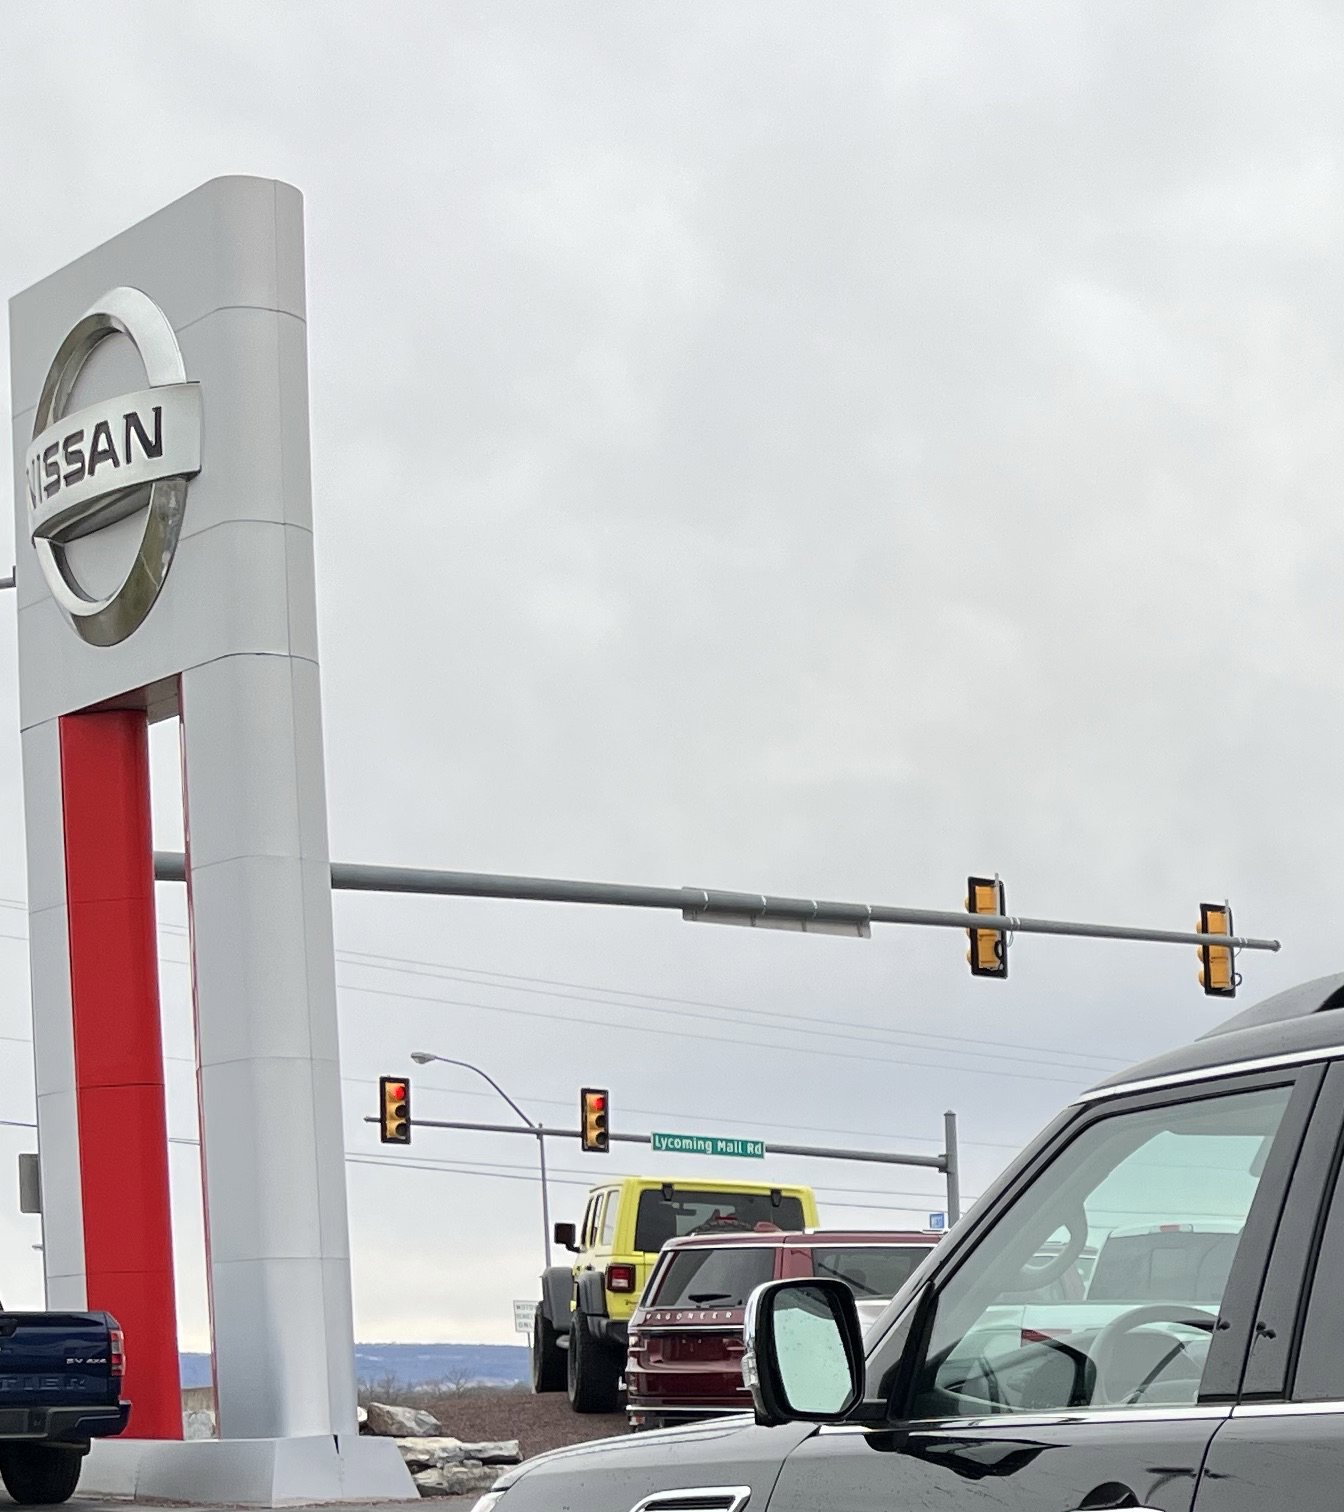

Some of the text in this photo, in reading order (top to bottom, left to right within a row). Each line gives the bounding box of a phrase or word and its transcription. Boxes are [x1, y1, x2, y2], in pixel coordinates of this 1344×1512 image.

[26, 406, 163, 510] NISSAN
[655, 1134, 762, 1155] Lycoming Mall Rd
